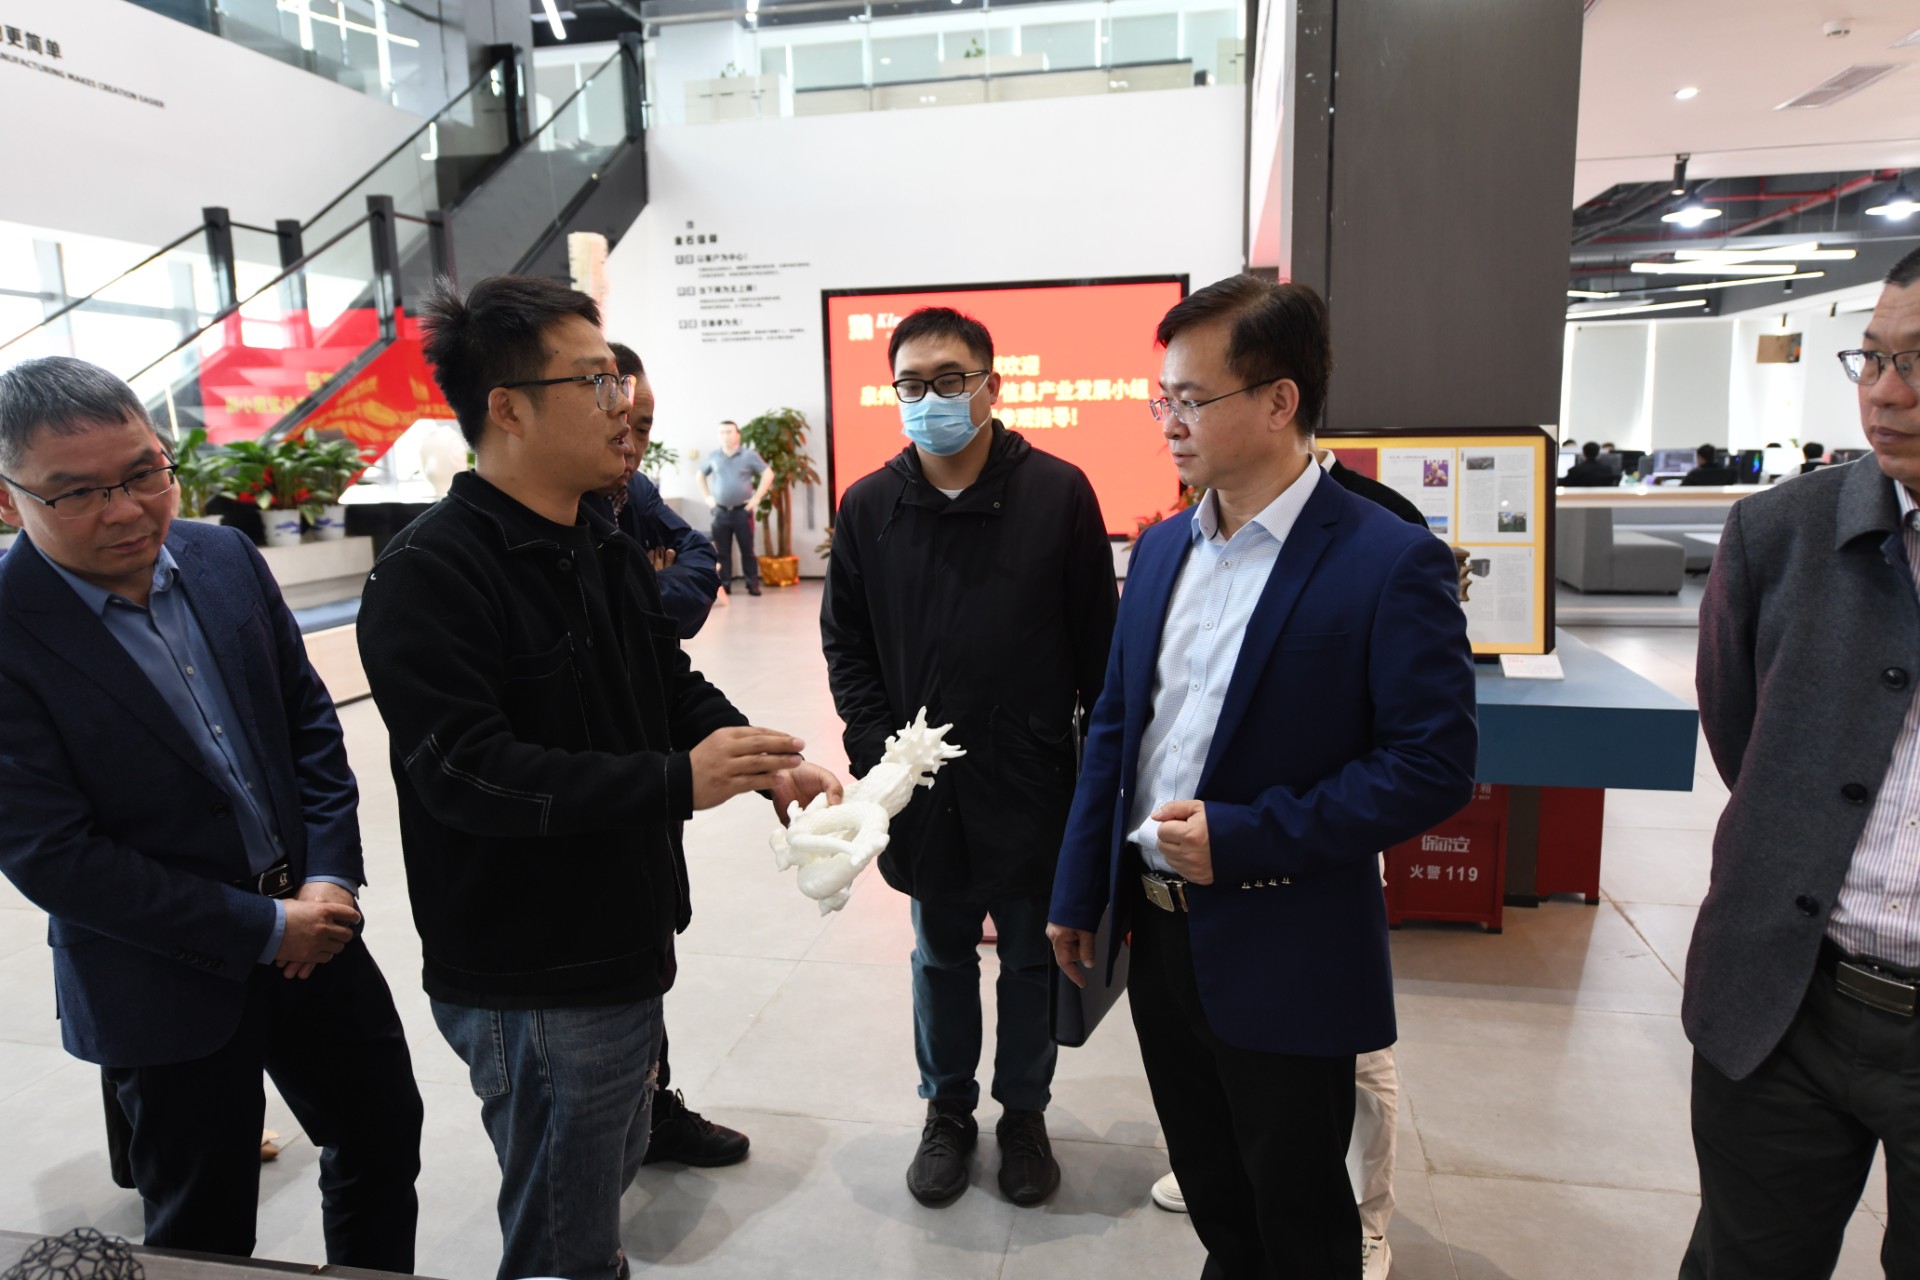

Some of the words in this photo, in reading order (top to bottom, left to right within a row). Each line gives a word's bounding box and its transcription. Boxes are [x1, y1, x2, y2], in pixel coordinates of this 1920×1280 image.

[0, 24, 63, 59] 更简单
[67, 72, 96, 88] MAKES
[99, 82, 138, 100] CREATION
[875, 312, 904, 329] Kin
